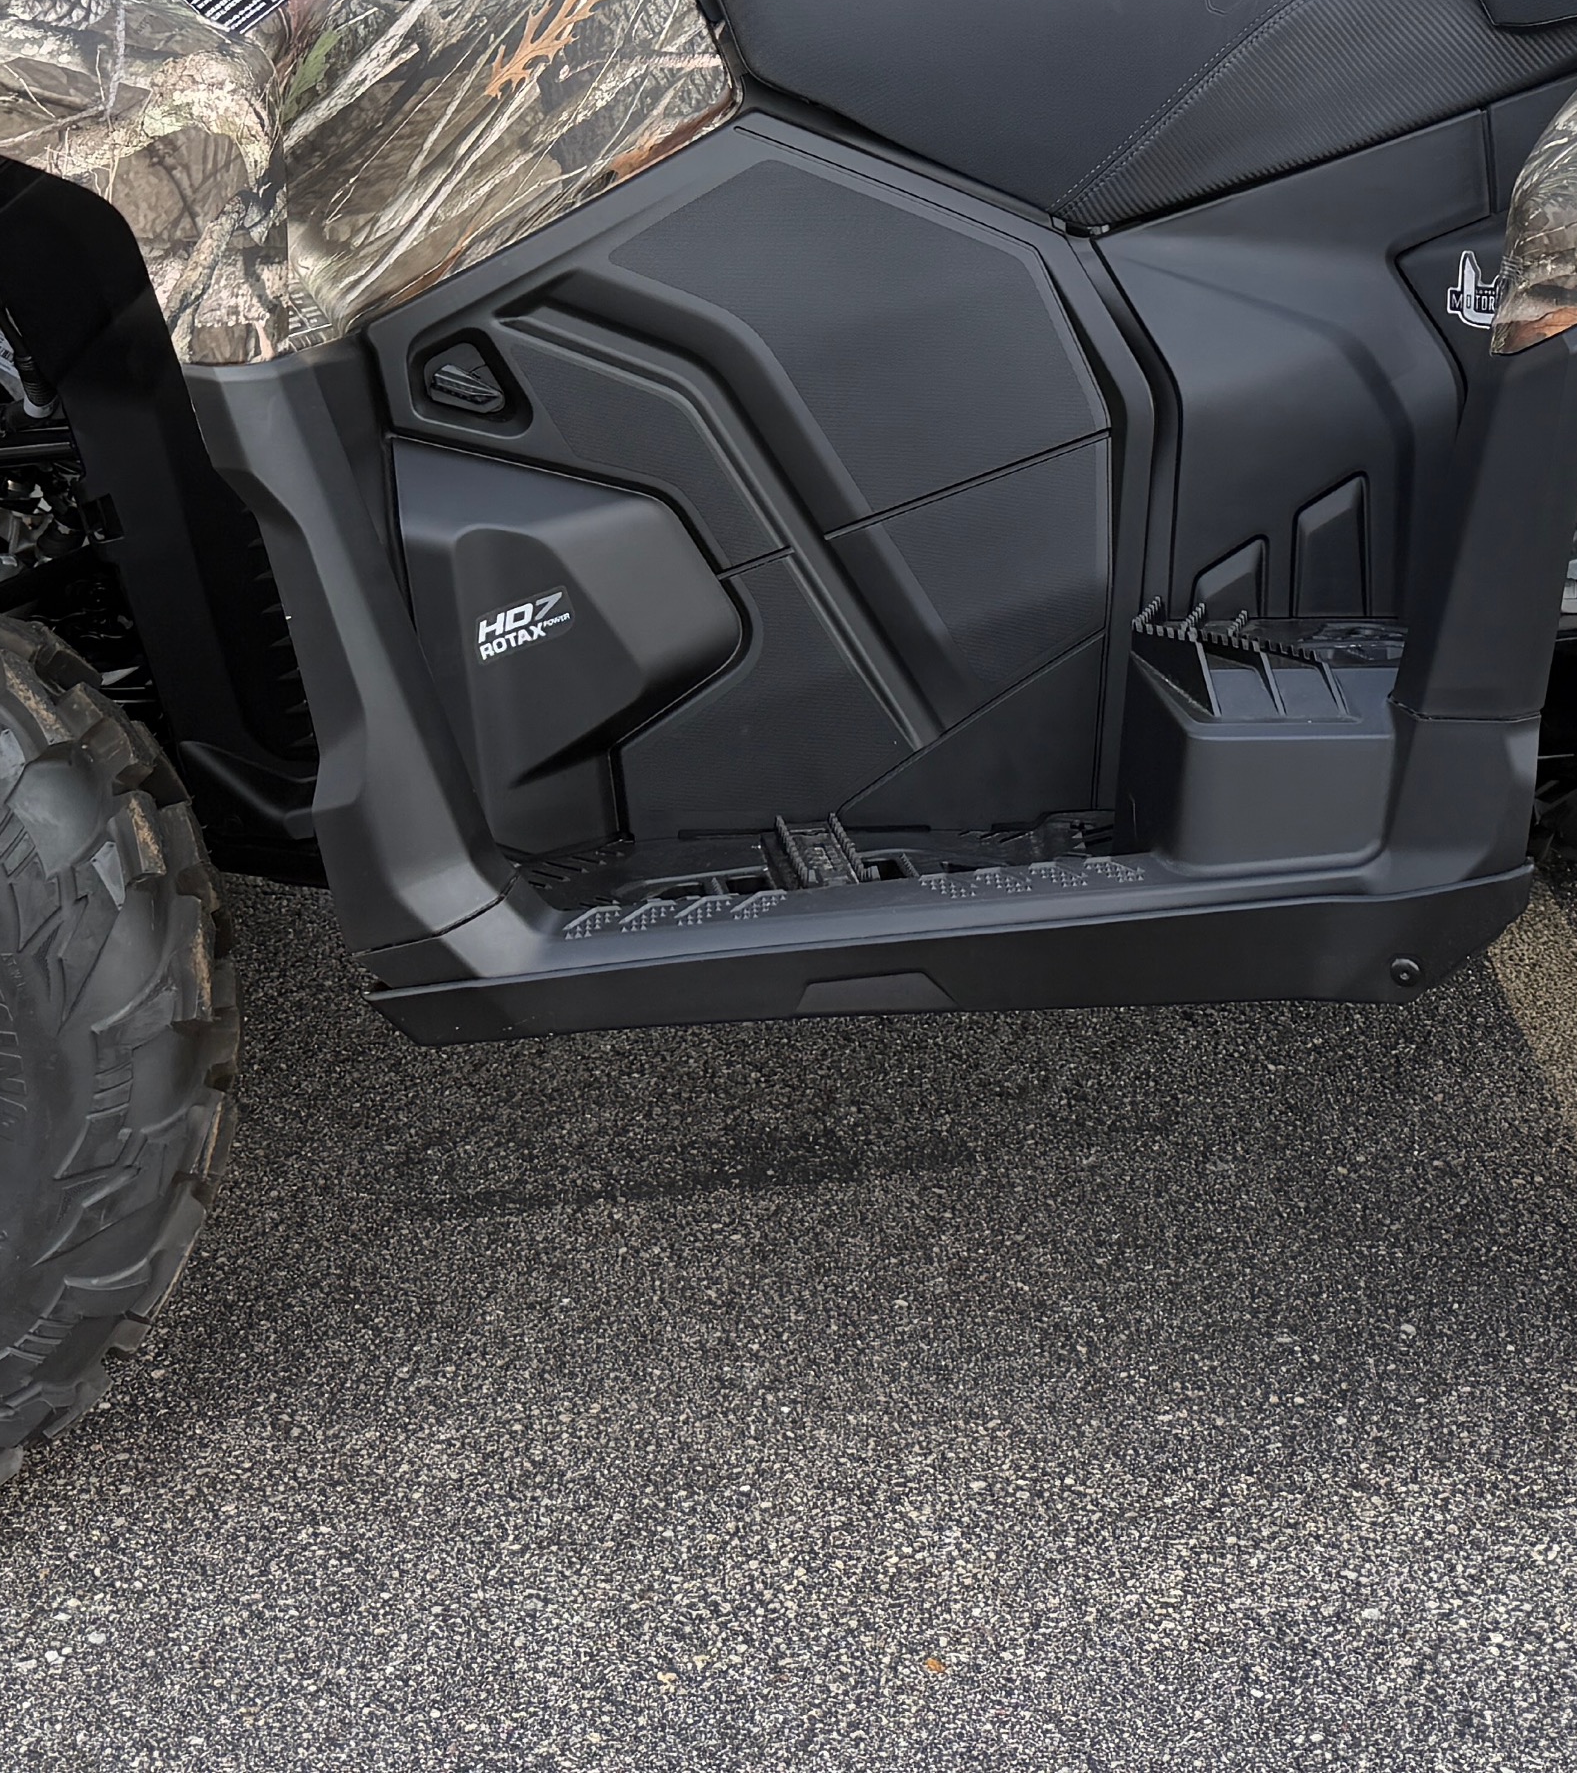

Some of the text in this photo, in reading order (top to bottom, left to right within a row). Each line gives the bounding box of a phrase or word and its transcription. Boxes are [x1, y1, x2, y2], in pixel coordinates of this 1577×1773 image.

[477, 590, 563, 644] HD7
[479, 612, 571, 661] ROTAX POWER
